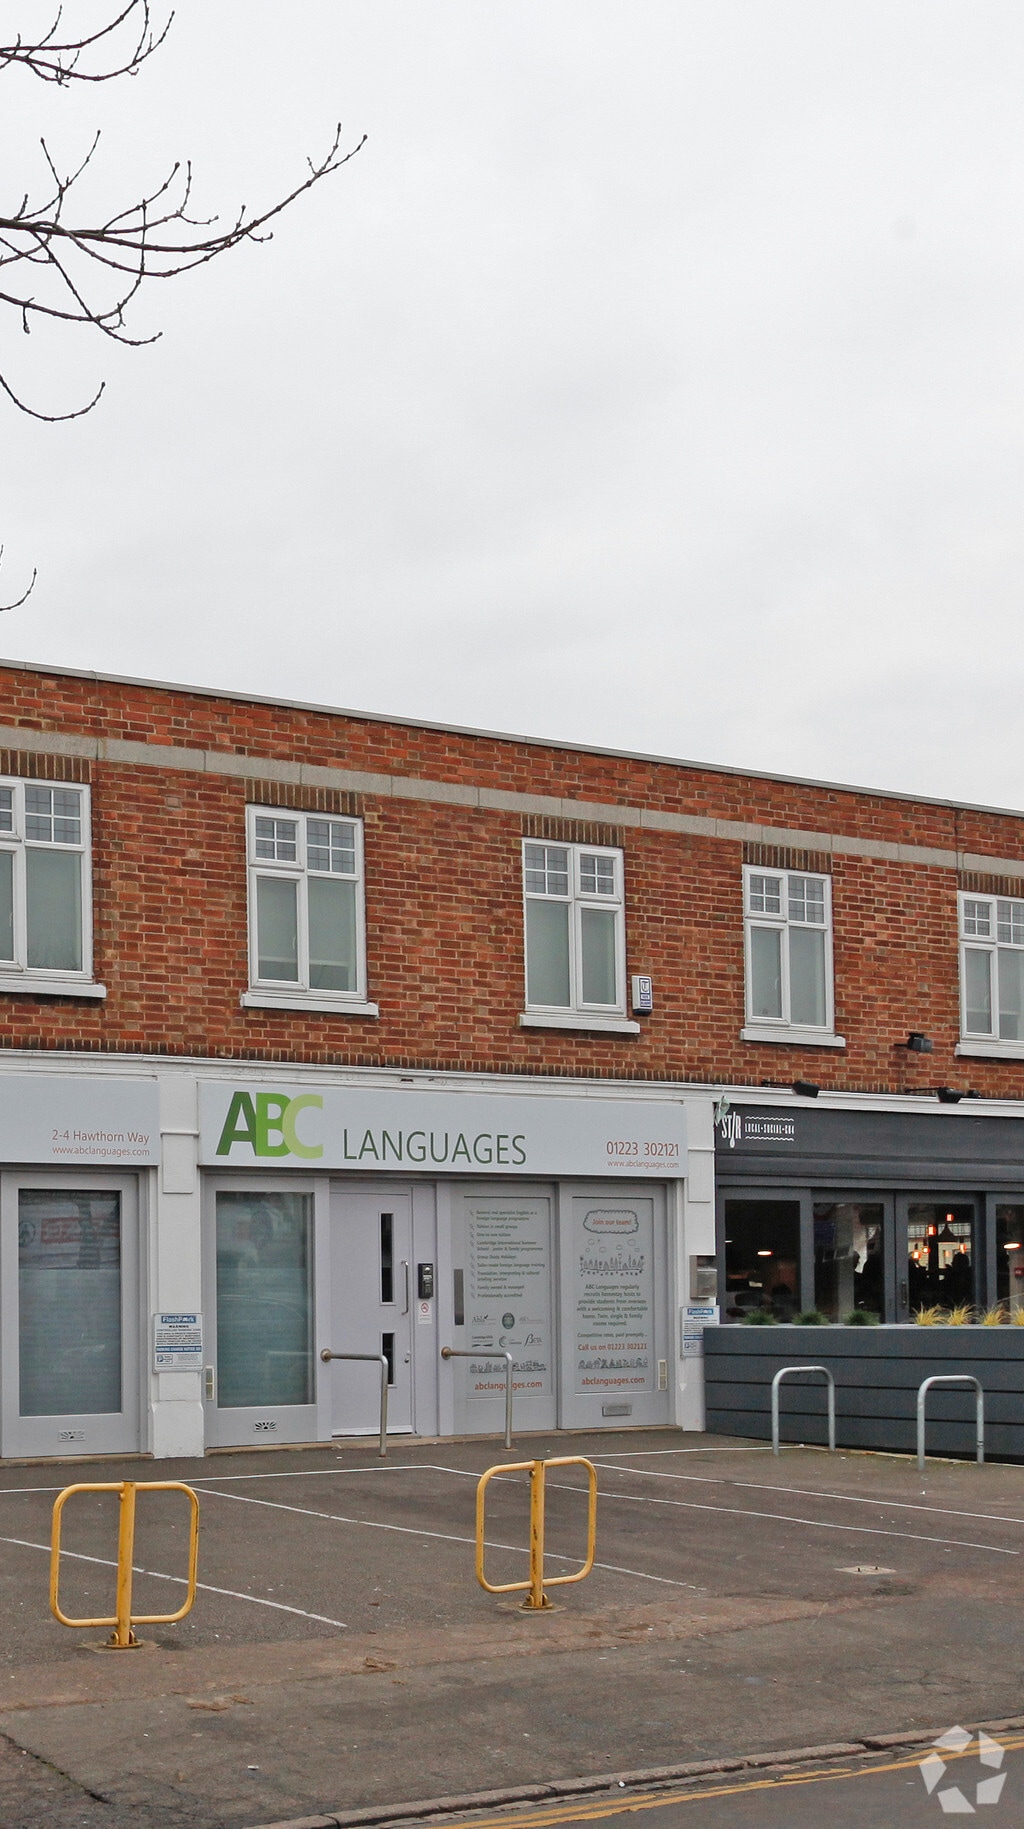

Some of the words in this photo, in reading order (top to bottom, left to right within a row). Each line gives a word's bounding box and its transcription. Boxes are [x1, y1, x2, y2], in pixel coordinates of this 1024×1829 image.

[216, 1091, 323, 1159] ABC
[344, 1128, 526, 1165] LANGUAGES
[52, 1130, 69, 1140] 2-4
[74, 1130, 124, 1142] Hawthorn
[127, 1132, 149, 1146] Way
[52, 1146, 149, 1157] www.abclanguages.com
[607, 1141, 638, 1155] 01223
[644, 1142, 679, 1156] 302121
[607, 1160, 679, 1170] www.abclanguages.com
[475, 1381, 542, 1391] abclanguges.com
[581, 1377, 645, 1386] abclanguages.com
